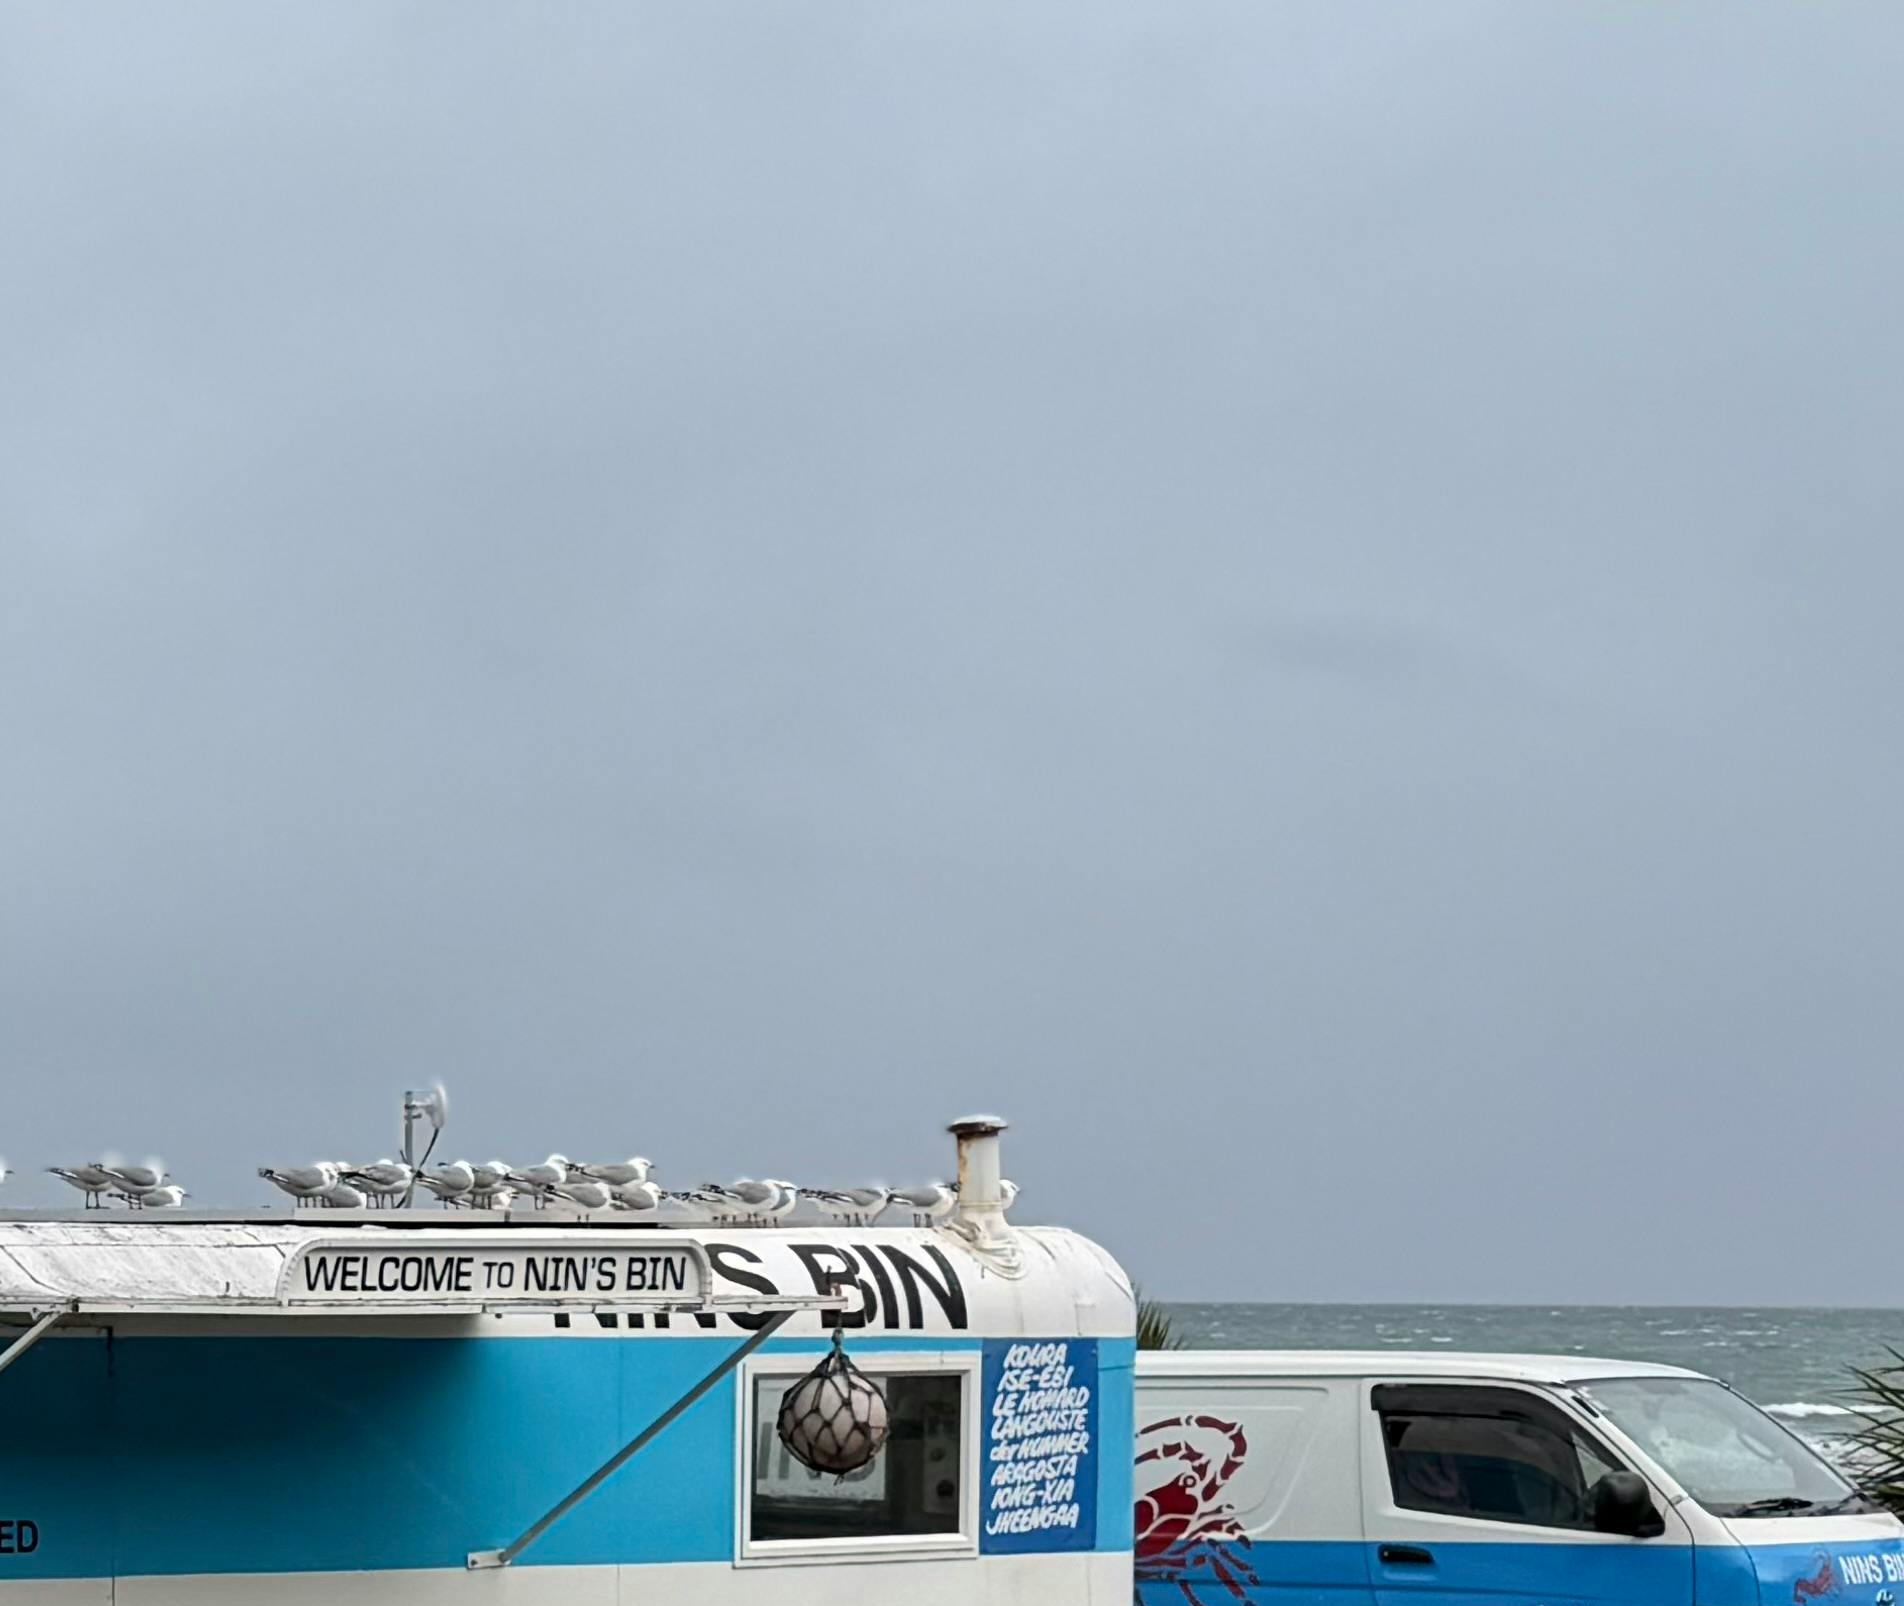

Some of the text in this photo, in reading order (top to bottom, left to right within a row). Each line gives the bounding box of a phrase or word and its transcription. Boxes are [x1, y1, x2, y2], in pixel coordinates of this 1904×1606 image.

[303, 1256, 475, 1292] WELCOME
[482, 1261, 515, 1289] TO
[523, 1256, 617, 1292] NIN'S
[625, 1256, 687, 1292] BIN
[786, 1243, 969, 1330] BIN
[1003, 1343, 1068, 1369] KOURA
[997, 1365, 1075, 1392] ISE-EBI
[992, 1386, 1090, 1417] LE HOMARD
[991, 1408, 1089, 1440] LANGOUSTE
[991, 1455, 1079, 1486] ARAGOSTA
[1838, 1554, 1883, 1585] NINS
